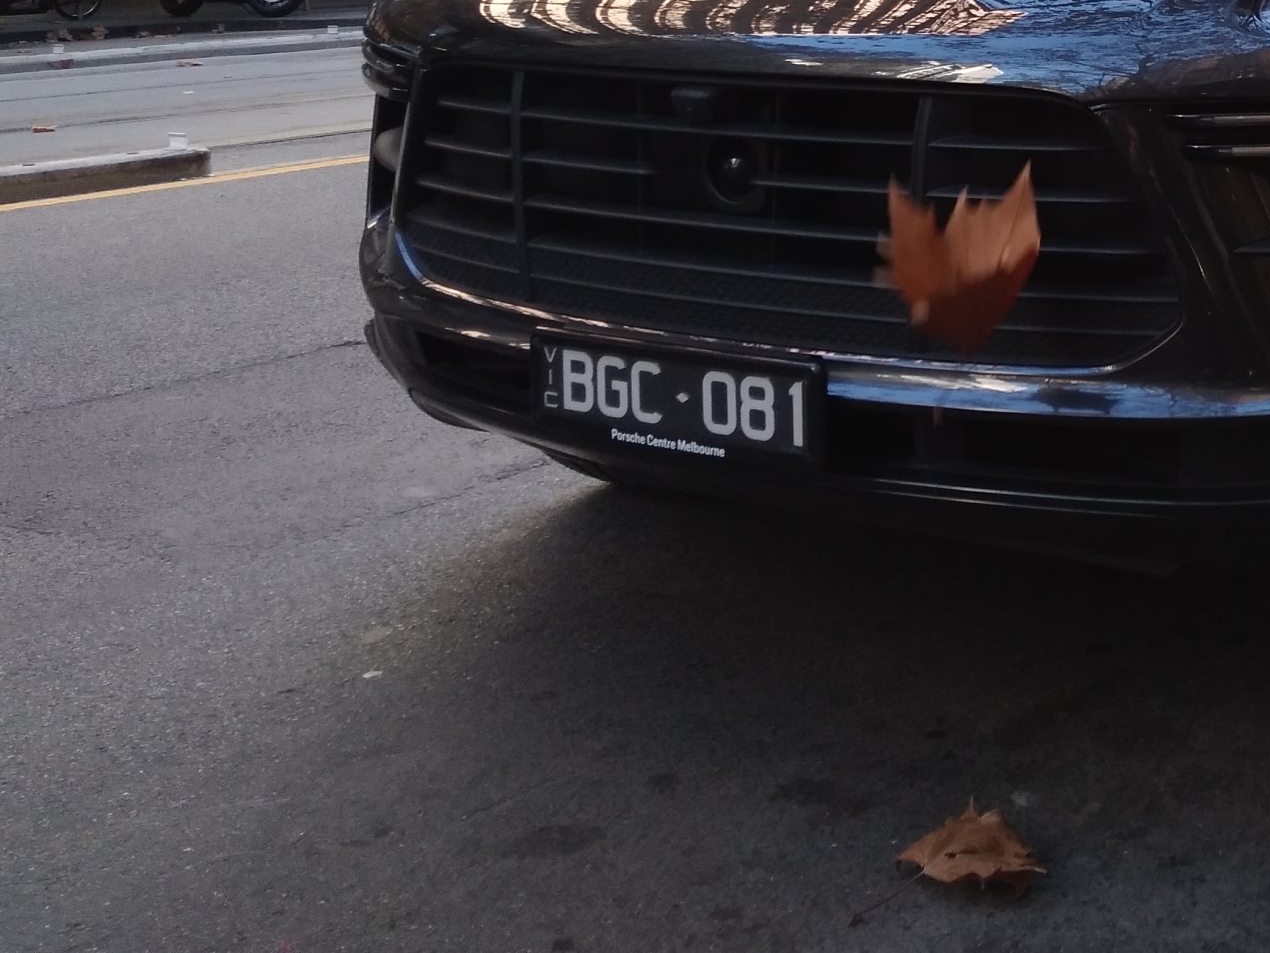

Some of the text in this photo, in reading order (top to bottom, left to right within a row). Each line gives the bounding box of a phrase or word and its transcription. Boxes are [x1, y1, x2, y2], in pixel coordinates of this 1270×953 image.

[544, 347, 559, 409] VIC
[562, 349, 804, 447] BGC 081
[611, 428, 726, 458] Porsche Centre Melbourne
